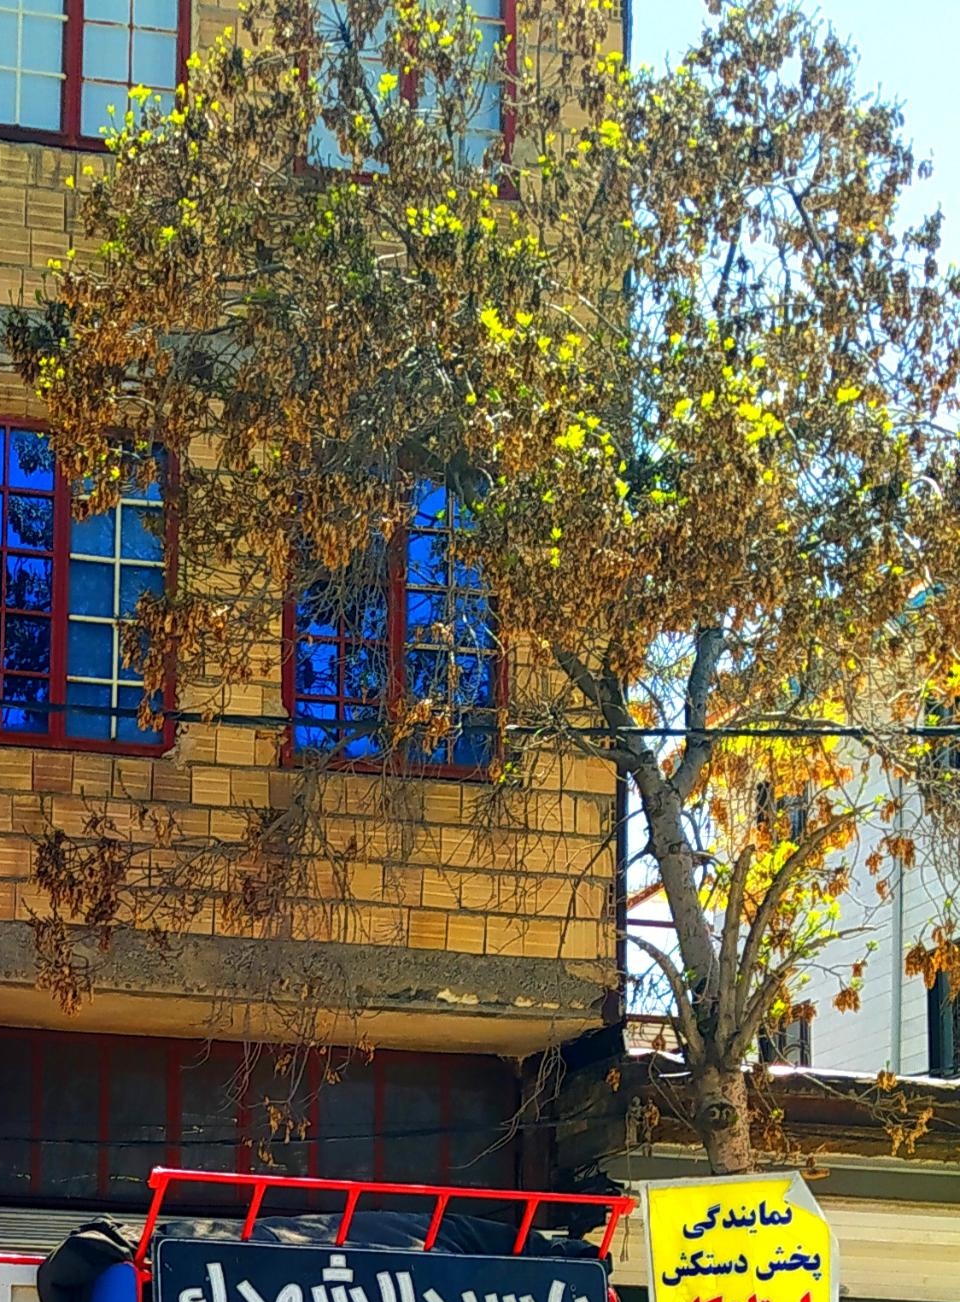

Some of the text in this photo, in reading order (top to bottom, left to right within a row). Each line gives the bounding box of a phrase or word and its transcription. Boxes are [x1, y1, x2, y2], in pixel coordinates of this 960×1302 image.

[683, 1200, 792, 1239] نمایندگی
[662, 1245, 822, 1286] پخش دستکش
